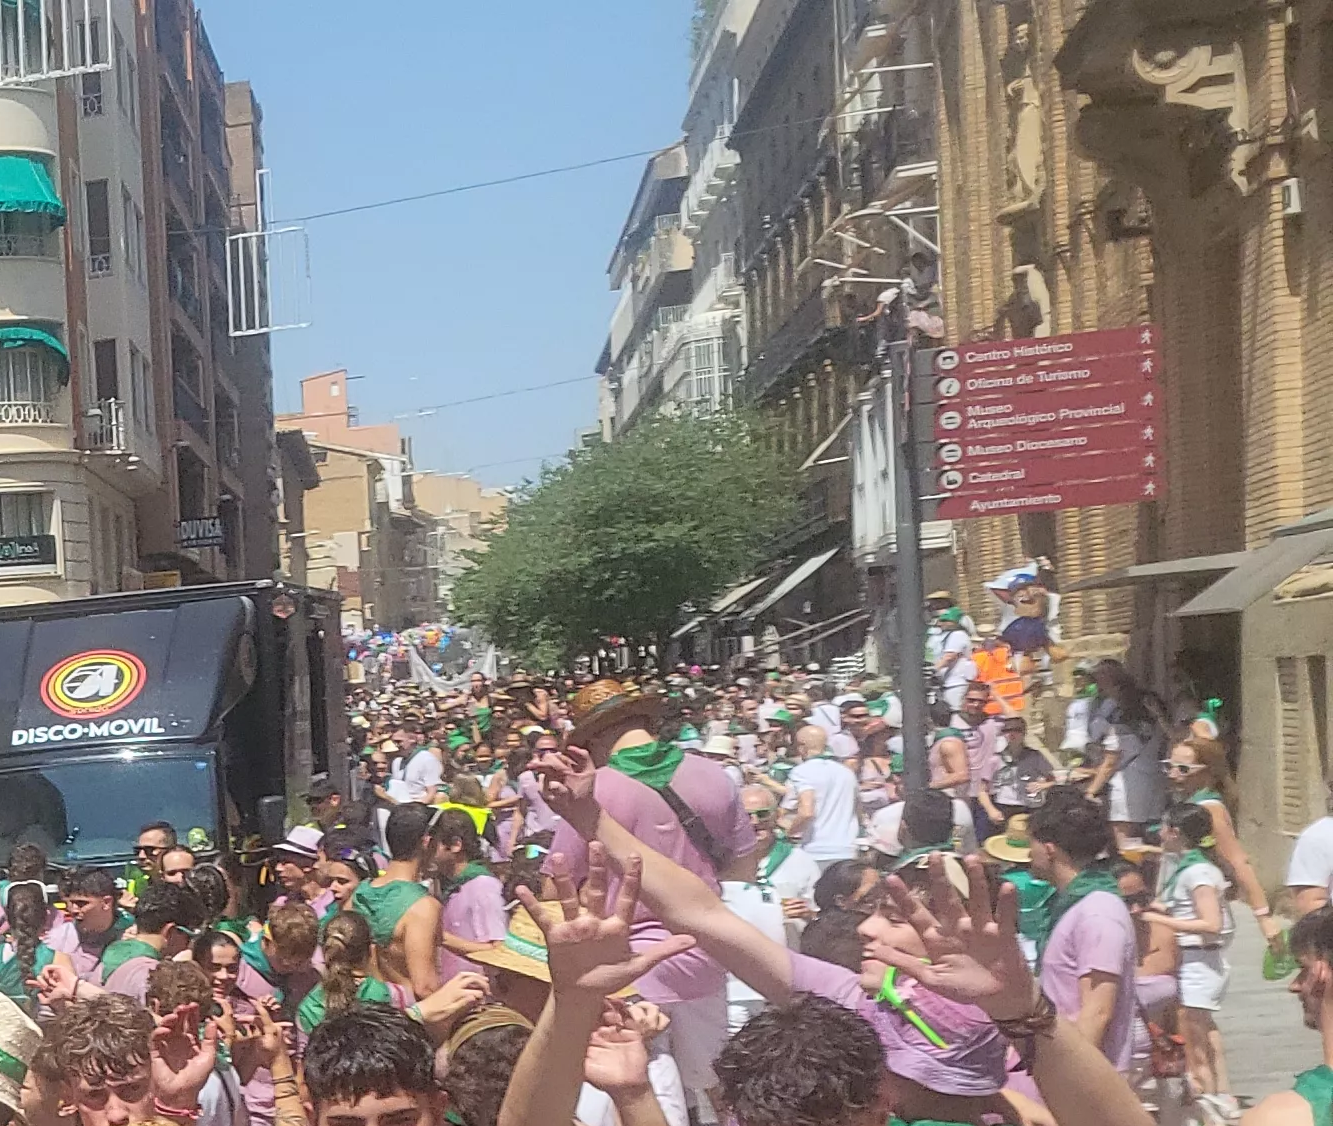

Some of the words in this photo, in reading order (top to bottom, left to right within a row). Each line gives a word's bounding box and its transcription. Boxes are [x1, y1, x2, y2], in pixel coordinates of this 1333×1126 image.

[965, 350, 1011, 363] Centro
[1013, 342, 1073, 357] Histórico
[966, 377, 1013, 390] Oficina
[1016, 375, 1034, 386] de
[1036, 368, 1091, 382] Turismo
[966, 403, 1013, 418] Museo
[967, 413, 1056, 429] Arqueológico
[1060, 402, 1125, 419] Provincial
[967, 443, 1013, 457] Museo
[1016, 436, 1088, 452] Diocesano
[968, 468, 1026, 484] Catedral
[969, 494, 1062, 512] Ayuntamiento
